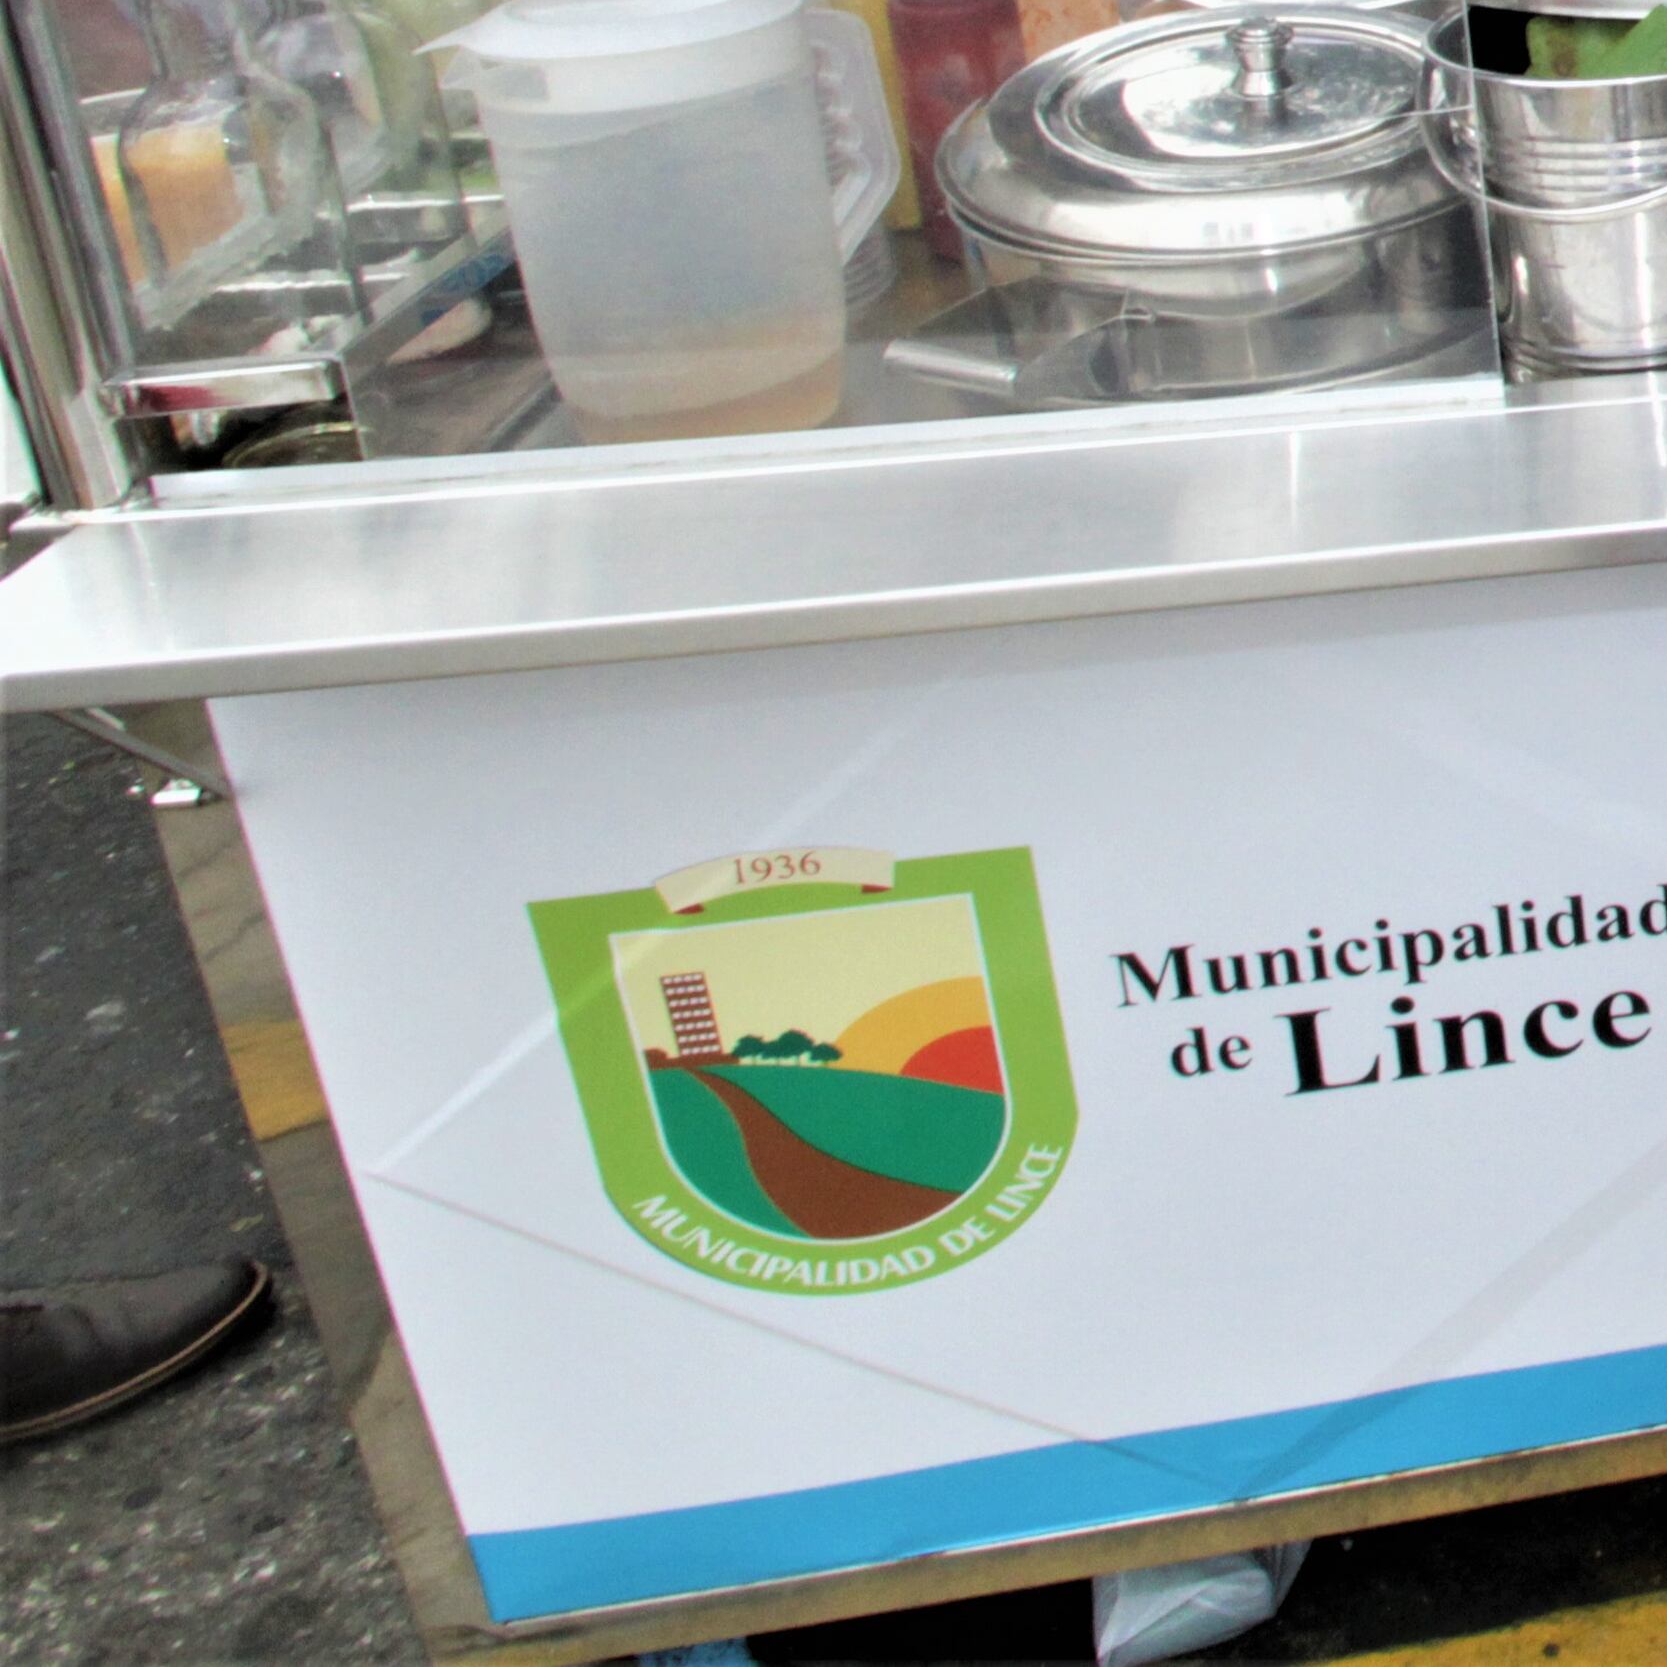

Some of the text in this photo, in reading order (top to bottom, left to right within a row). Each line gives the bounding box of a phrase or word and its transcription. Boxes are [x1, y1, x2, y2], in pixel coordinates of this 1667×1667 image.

[733, 851, 822, 885] 1936
[1169, 988, 1652, 1097] de Lince
[632, 1142, 1062, 1287] MUNICIPALIDAD DE LINCE
